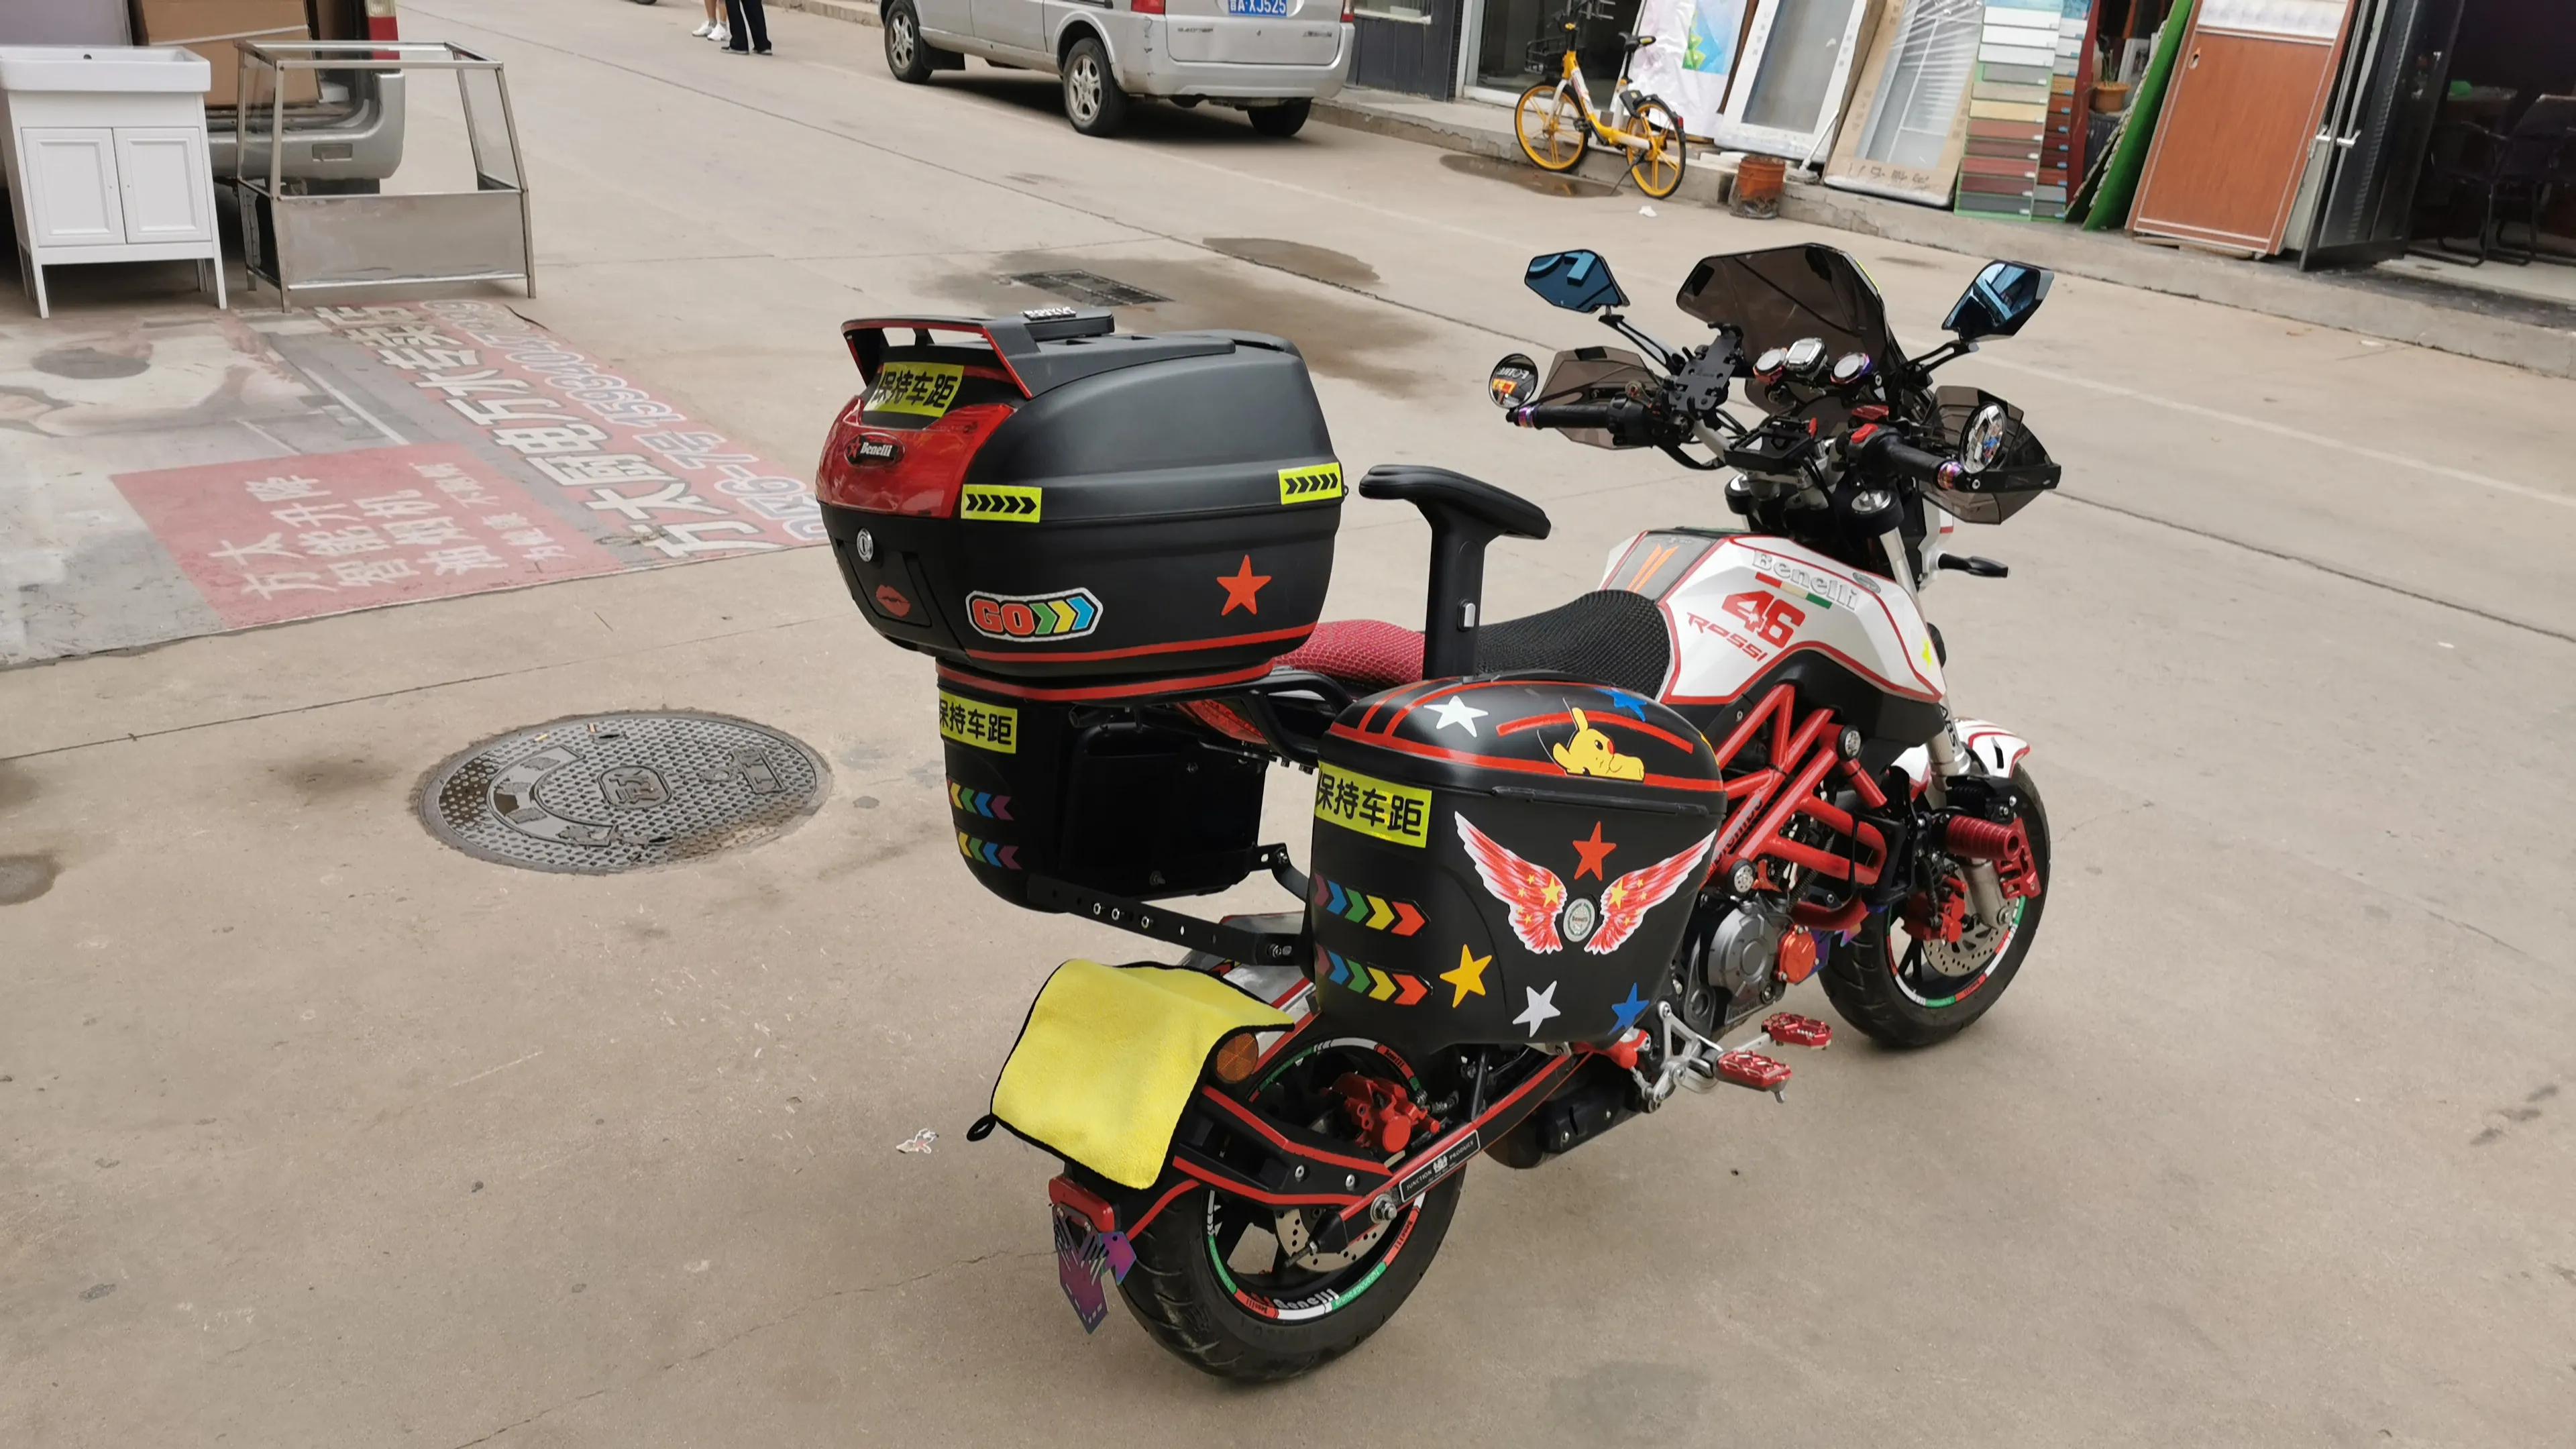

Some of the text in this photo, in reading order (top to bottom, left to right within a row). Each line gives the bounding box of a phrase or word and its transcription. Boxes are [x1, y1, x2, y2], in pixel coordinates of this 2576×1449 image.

[873, 370, 958, 409] 保持车距
[860, 441, 893, 458] Benelli
[208, 532, 338, 601] 方太
[1752, 549, 1858, 610] Benelli
[972, 598, 1036, 635] GO
[1721, 590, 1806, 649] 46
[939, 698, 1012, 745] 保持车距
[1316, 770, 1425, 837] 保持车距
